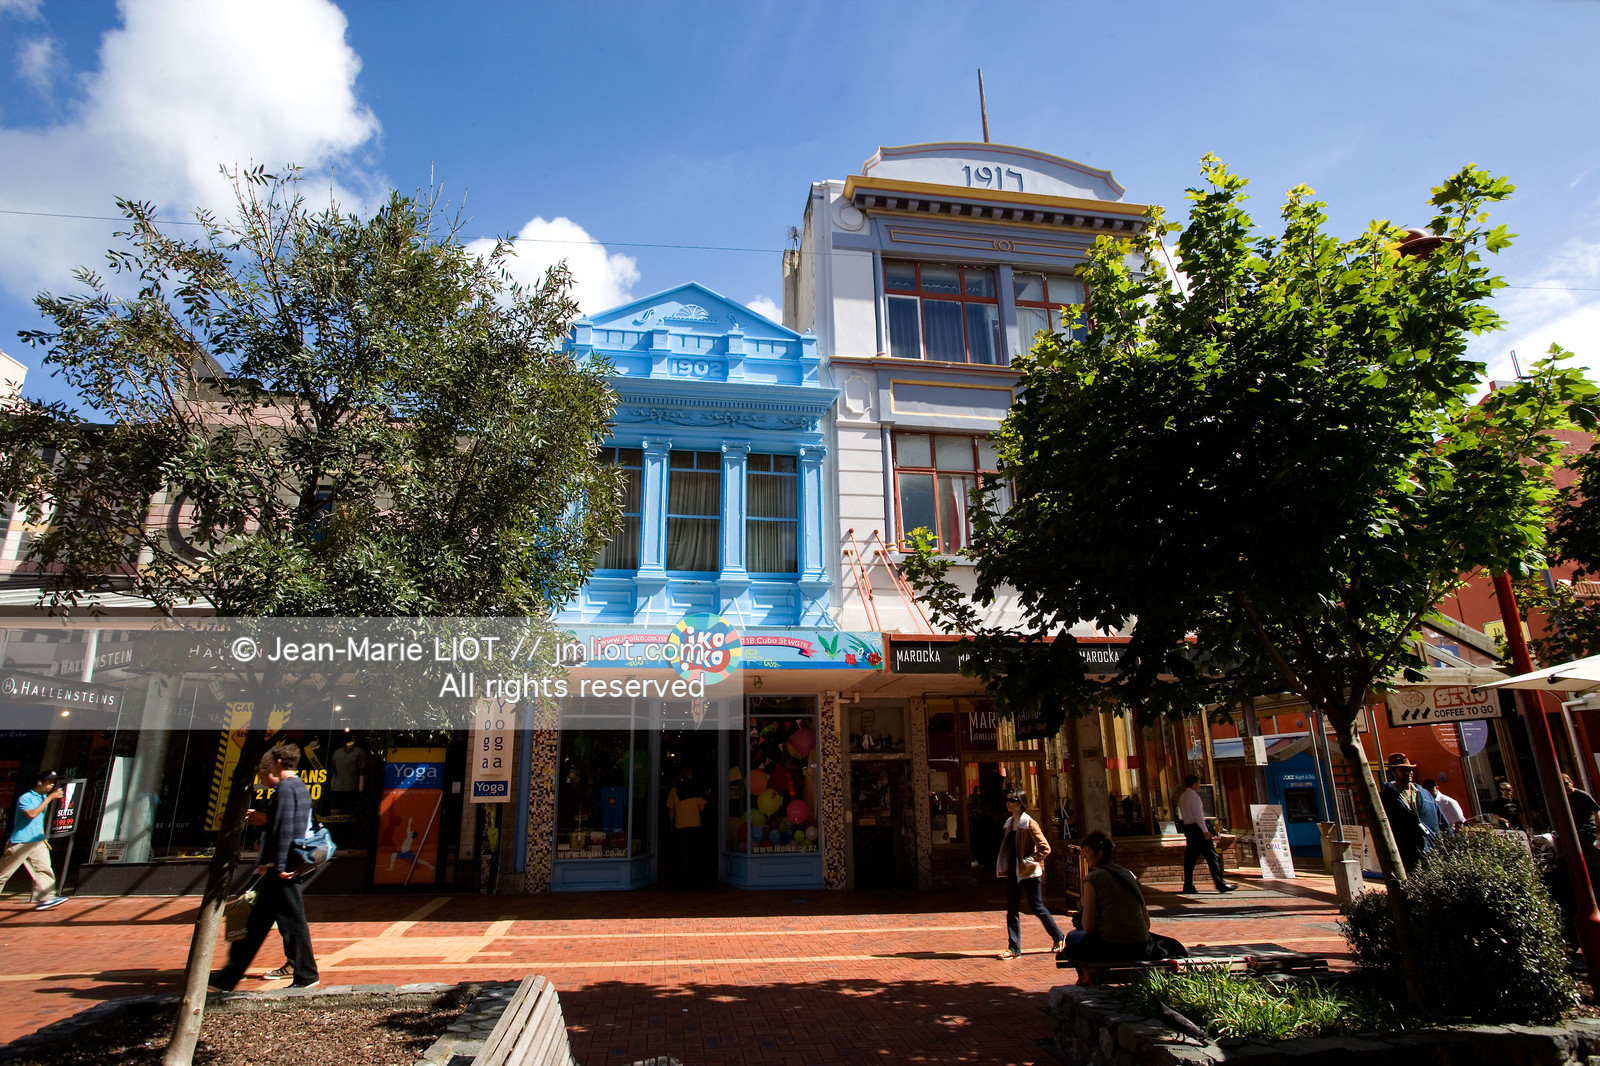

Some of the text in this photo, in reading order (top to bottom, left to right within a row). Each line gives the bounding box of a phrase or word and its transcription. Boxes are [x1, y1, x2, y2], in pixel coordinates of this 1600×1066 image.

[962, 165, 1023, 192] 1917
[672, 360, 723, 376] 1902
[600, 635, 668, 646] www.ikoiko.co.nz
[742, 637, 809, 650] 118 Cuba St WGTN
[61, 649, 133, 675] HALLNSTEIN
[896, 642, 941, 671] MAROCKA
[20, 681, 115, 706] HALLENSTEINS
[1434, 705, 1494, 718] COFFEE TO GO
[393, 763, 438, 781] Yoga
[476, 782, 505, 793] Yoga
[558, 849, 626, 858] www.ikoiko.co.nz
[753, 844, 817, 853] www.ikoiko.co.nz
